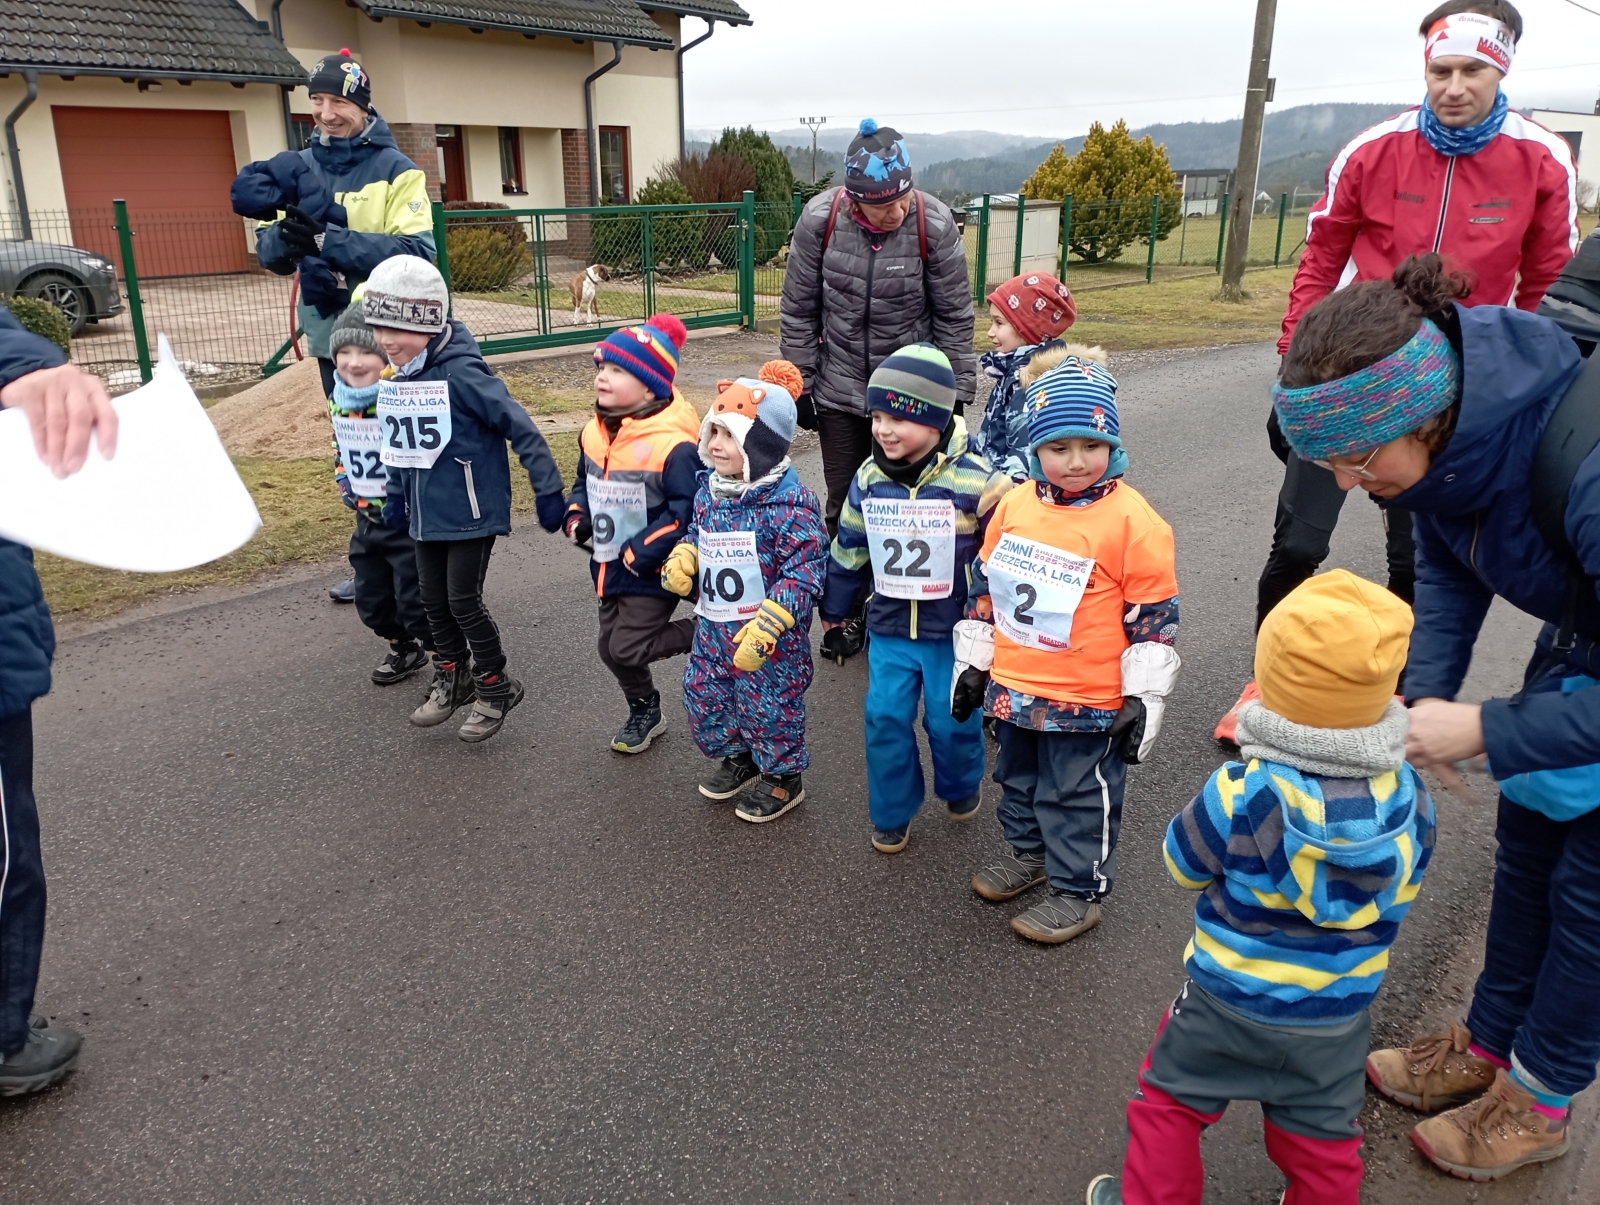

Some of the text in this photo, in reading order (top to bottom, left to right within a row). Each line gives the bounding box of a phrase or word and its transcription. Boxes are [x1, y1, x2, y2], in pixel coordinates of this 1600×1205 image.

[419, 398, 447, 407] LIGA
[385, 415, 442, 450] 215
[348, 449, 387, 479] 52
[616, 497, 642, 505] LIGA
[921, 519, 951, 528] LIGA
[726, 549, 754, 558] LIGA
[882, 538, 931, 577] 22
[1034, 553, 1087, 573] 2025-2026
[702, 567, 745, 602] 40
[1050, 569, 1082, 587] LIGA
[737, 602, 762, 613] MARATO
[1013, 583, 1037, 626] 2
